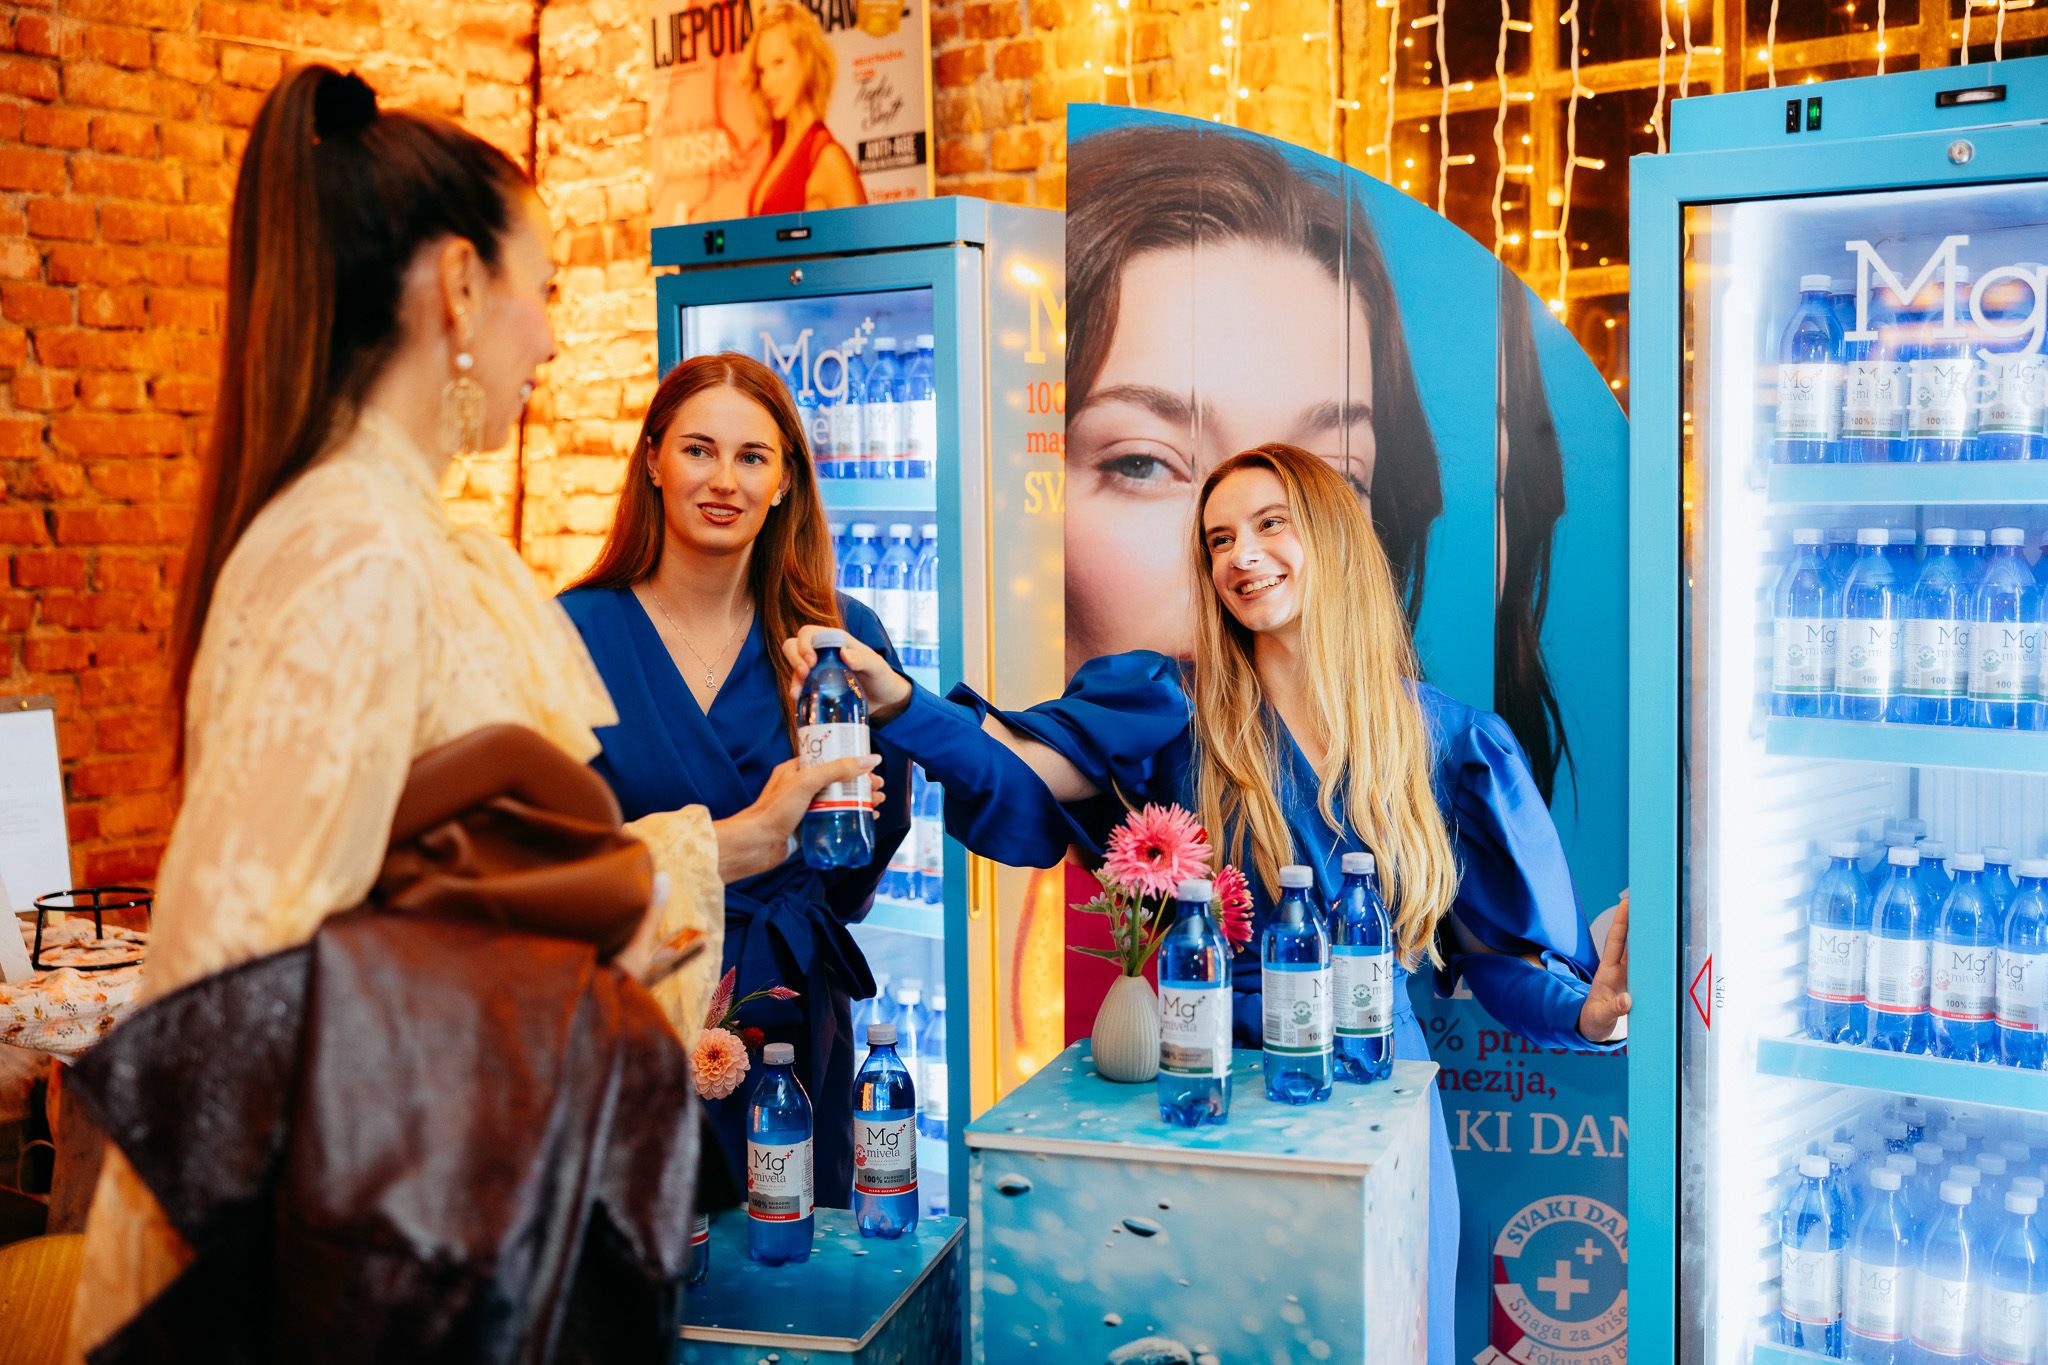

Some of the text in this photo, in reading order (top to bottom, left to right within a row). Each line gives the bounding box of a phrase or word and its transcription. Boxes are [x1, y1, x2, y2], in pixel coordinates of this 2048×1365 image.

[653, 0, 753, 69] LJEPOTA
[1024, 470, 1066, 514] SV
[1715, 975, 1726, 1009] OPEN
[866, 1148, 901, 1158] mivela
[753, 1172, 787, 1183] mivela
[863, 1174, 882, 1184] 100%
[1507, 1200, 1577, 1245] SVAKI
[1509, 1297, 1562, 1341] Snaga
[1569, 1328, 1591, 1342] za
